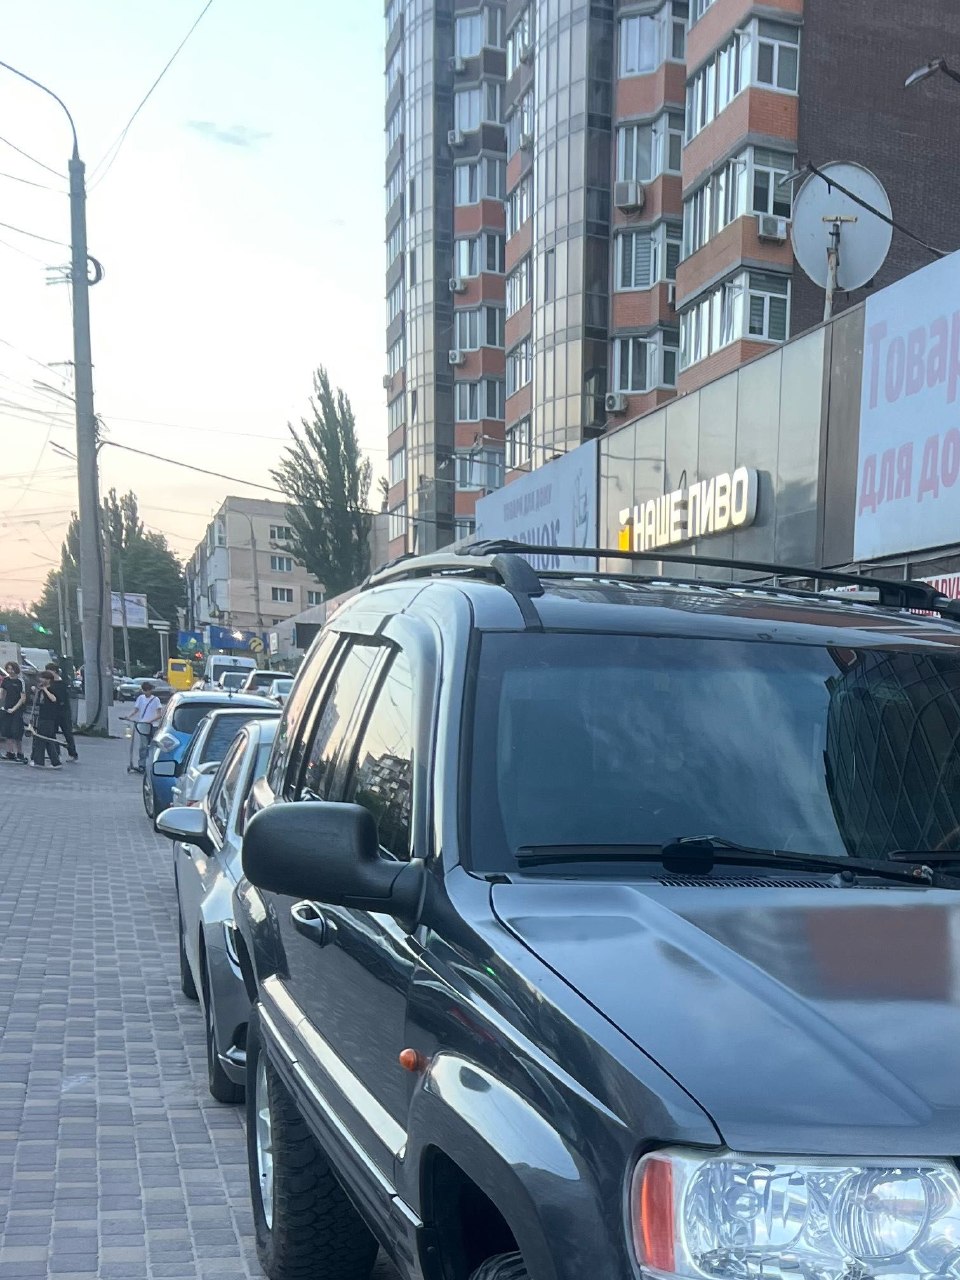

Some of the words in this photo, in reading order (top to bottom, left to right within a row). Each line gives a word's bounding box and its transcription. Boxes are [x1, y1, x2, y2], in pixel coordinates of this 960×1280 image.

[633, 489, 685, 552] НАШЕ
[688, 466, 750, 538] ПИВО
[858, 441, 913, 517] для
